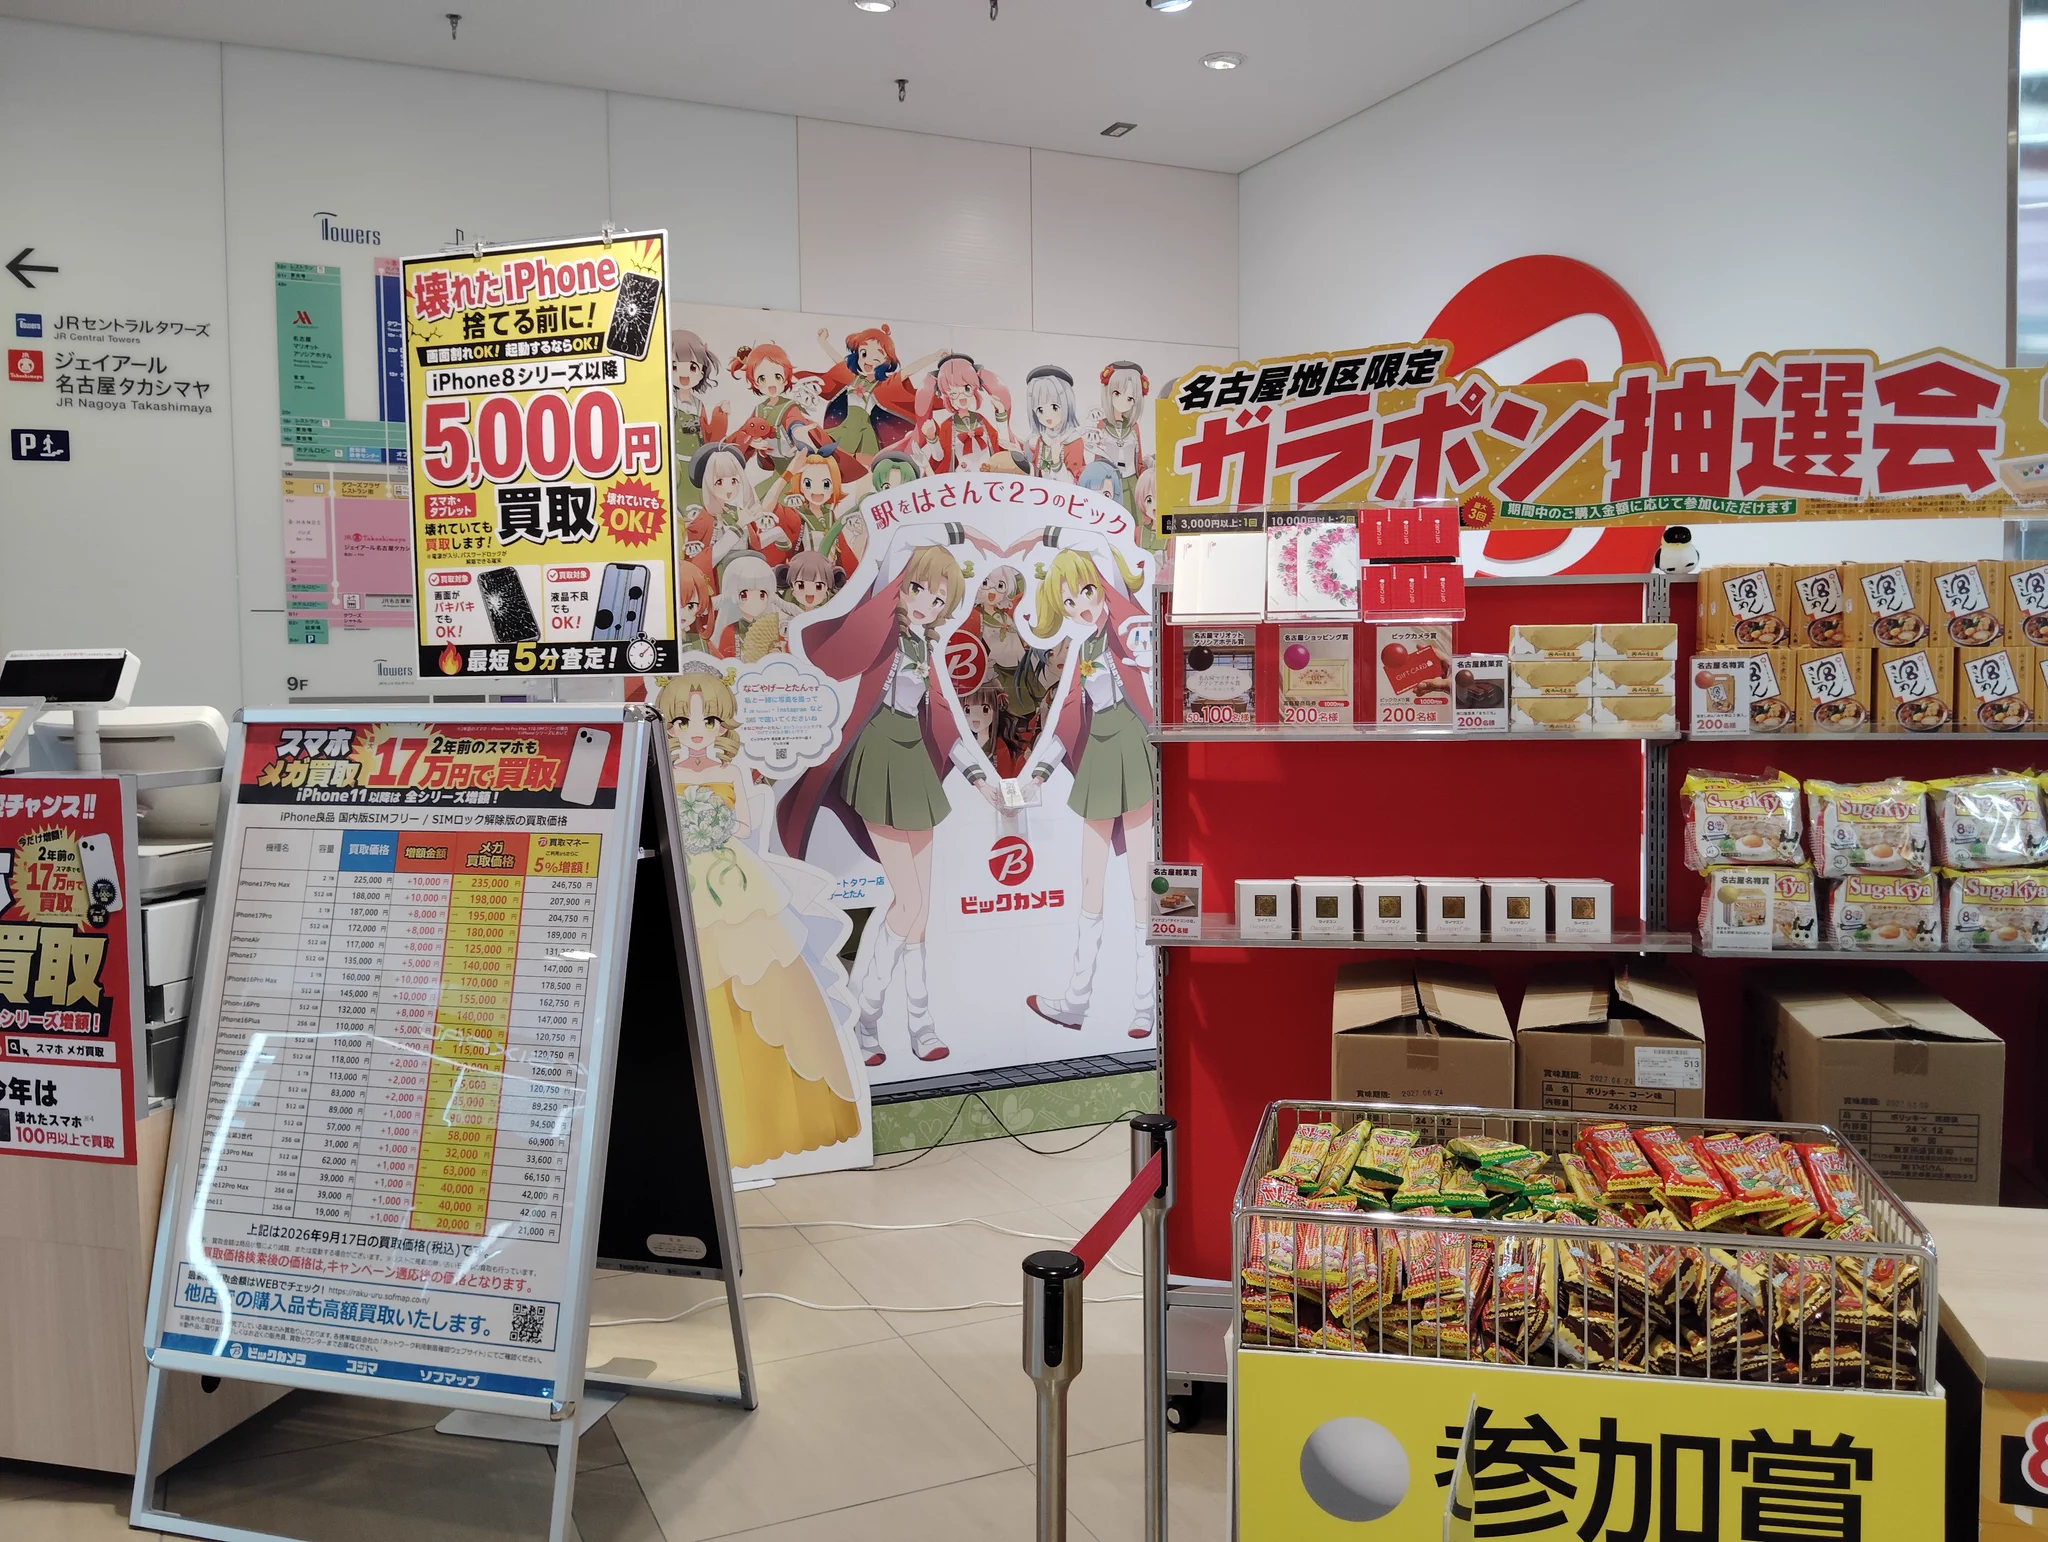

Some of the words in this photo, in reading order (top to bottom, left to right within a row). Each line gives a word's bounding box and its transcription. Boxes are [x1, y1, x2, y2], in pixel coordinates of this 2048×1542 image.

[313, 211, 381, 245] Towers
[414, 258, 617, 320] 壊れたiPhone
[53, 316, 210, 338] JRセントラルタワーズ
[462, 302, 597, 340] 捨てる前に!
[54, 332, 67, 341] JR
[69, 332, 104, 343] Central
[108, 334, 141, 344] Towers
[426, 344, 500, 365] 画面割れOK!
[504, 337, 599, 358] 起動するならOK!
[54, 351, 167, 374] ジェイアール
[432, 360, 619, 392] iPhone8シリーズ以降
[1178, 348, 1444, 411] 名古屋地区限定
[56, 374, 210, 400] 名古屋タカシマヤ
[56, 397, 73, 408] JR
[79, 398, 127, 412] Nagoya
[131, 400, 213, 415] Takashimaya
[424, 390, 659, 484] 5,000円
[1180, 360, 2002, 509] ガラポン抽選会
[20, 433, 37, 457] P
[606, 493, 660, 509] 壊れていても
[1473, 501, 1488, 513] 最大
[430, 506, 472, 518] タブレット
[497, 485, 596, 540] 買取
[870, 480, 1130, 538] 駅をはさんで2つのビック
[1468, 508, 1488, 522] 3回
[1507, 498, 1793, 522] 期間中のご購入金額に応じて参加いただけます
[610, 507, 655, 534] OK!
[1179, 516, 1259, 530] 3,000円以上:1回
[425, 522, 493, 536] 壊れていても
[425, 537, 492, 551] 買取します!
[440, 574, 470, 585] 買取対象
[558, 570, 587, 581] 買取対象
[434, 591, 461, 600] 画面が
[550, 591, 589, 602] 液晶不良
[434, 601, 475, 612] バキバキ
[551, 604, 570, 613] でも
[435, 615, 453, 624] でも
[551, 616, 581, 630] OK!
[436, 626, 463, 638] OK!
[466, 642, 617, 672] 最短5分査定!
[373, 659, 414, 677] Towers
[287, 676, 309, 691] 9F
[743, 683, 820, 693] なごやげーとたんです
[1284, 708, 1339, 723] 200名様
[1382, 707, 1437, 722] 200名様
[276, 729, 353, 758] スマホ
[431, 736, 539, 755] 2年前のスマホも
[257, 759, 362, 788] メガ買取
[296, 790, 401, 804] iPhone11以降は
[404, 790, 500, 805] 全シリーズ増額!
[1707, 791, 1785, 812] Sugakiy
[1839, 799, 1921, 820] Sugakiya
[280, 812, 336, 824] iPhone良品
[338, 813, 420, 825] 国内版SIMフリー
[431, 814, 569, 828] SIMロック解除版の買取価格
[18, 830, 63, 848] 今だけ増額!
[548, 838, 590, 848] 買取マネー
[38, 846, 76, 862] 2年前の
[265, 844, 290, 853] 機種名
[318, 844, 335, 854] 容量
[348, 844, 390, 856] 買取価格
[404, 846, 448, 860] 増額金額
[479, 840, 505, 855] メガ
[465, 854, 516, 869] 買取価格
[533, 857, 590, 874] 5%増額!
[353, 876, 382, 885] 225,000
[471, 877, 510, 889] 235,000
[551, 881, 582, 890] 246,750
[1849, 876, 1933, 902] Sugakiya
[39, 892, 74, 913] 買取
[352, 892, 381, 900] 188,000
[469, 894, 507, 905] 198,000
[549, 898, 580, 906] 207,900
[960, 889, 1066, 916] ビックカメラ
[467, 911, 506, 921] 195,000
[546, 931, 577, 940] 189,000
[1152, 923, 1189, 934] 200名様
[462, 960, 500, 971] 140,000
[543, 964, 573, 974] 147,000
[36, 1043, 64, 1055] スマホ
[67, 1045, 105, 1058] メガ買取
[1684, 1059, 1700, 1069] 513
[1543, 1069, 1582, 1080] 賞味期限:
[331, 1088, 356, 1098] 83,000
[1585, 1087, 1625, 1099] ポリッキー
[1628, 1089, 1664, 1100] コーン味
[1608, 1102, 1637, 1112] 24×12
[15, 1111, 82, 1128] 壊れたスマホ
[16, 1126, 115, 1150] 100円以上で買取
[447, 1130, 480, 1142] 58,000
[443, 1165, 476, 1177] 63,000
[524, 1172, 550, 1183] 66,150
[436, 1217, 470, 1230] 20,000
[518, 1226, 545, 1237] 21,000
[188, 1269, 325, 1295] 最取金額はWEBでチェック!
[248, 1346, 307, 1366] ビックカメラ
[346, 1359, 379, 1375] コジマ
[420, 1369, 480, 1388] ソフマップ
[1435, 1406, 1873, 1542] 参加賞
